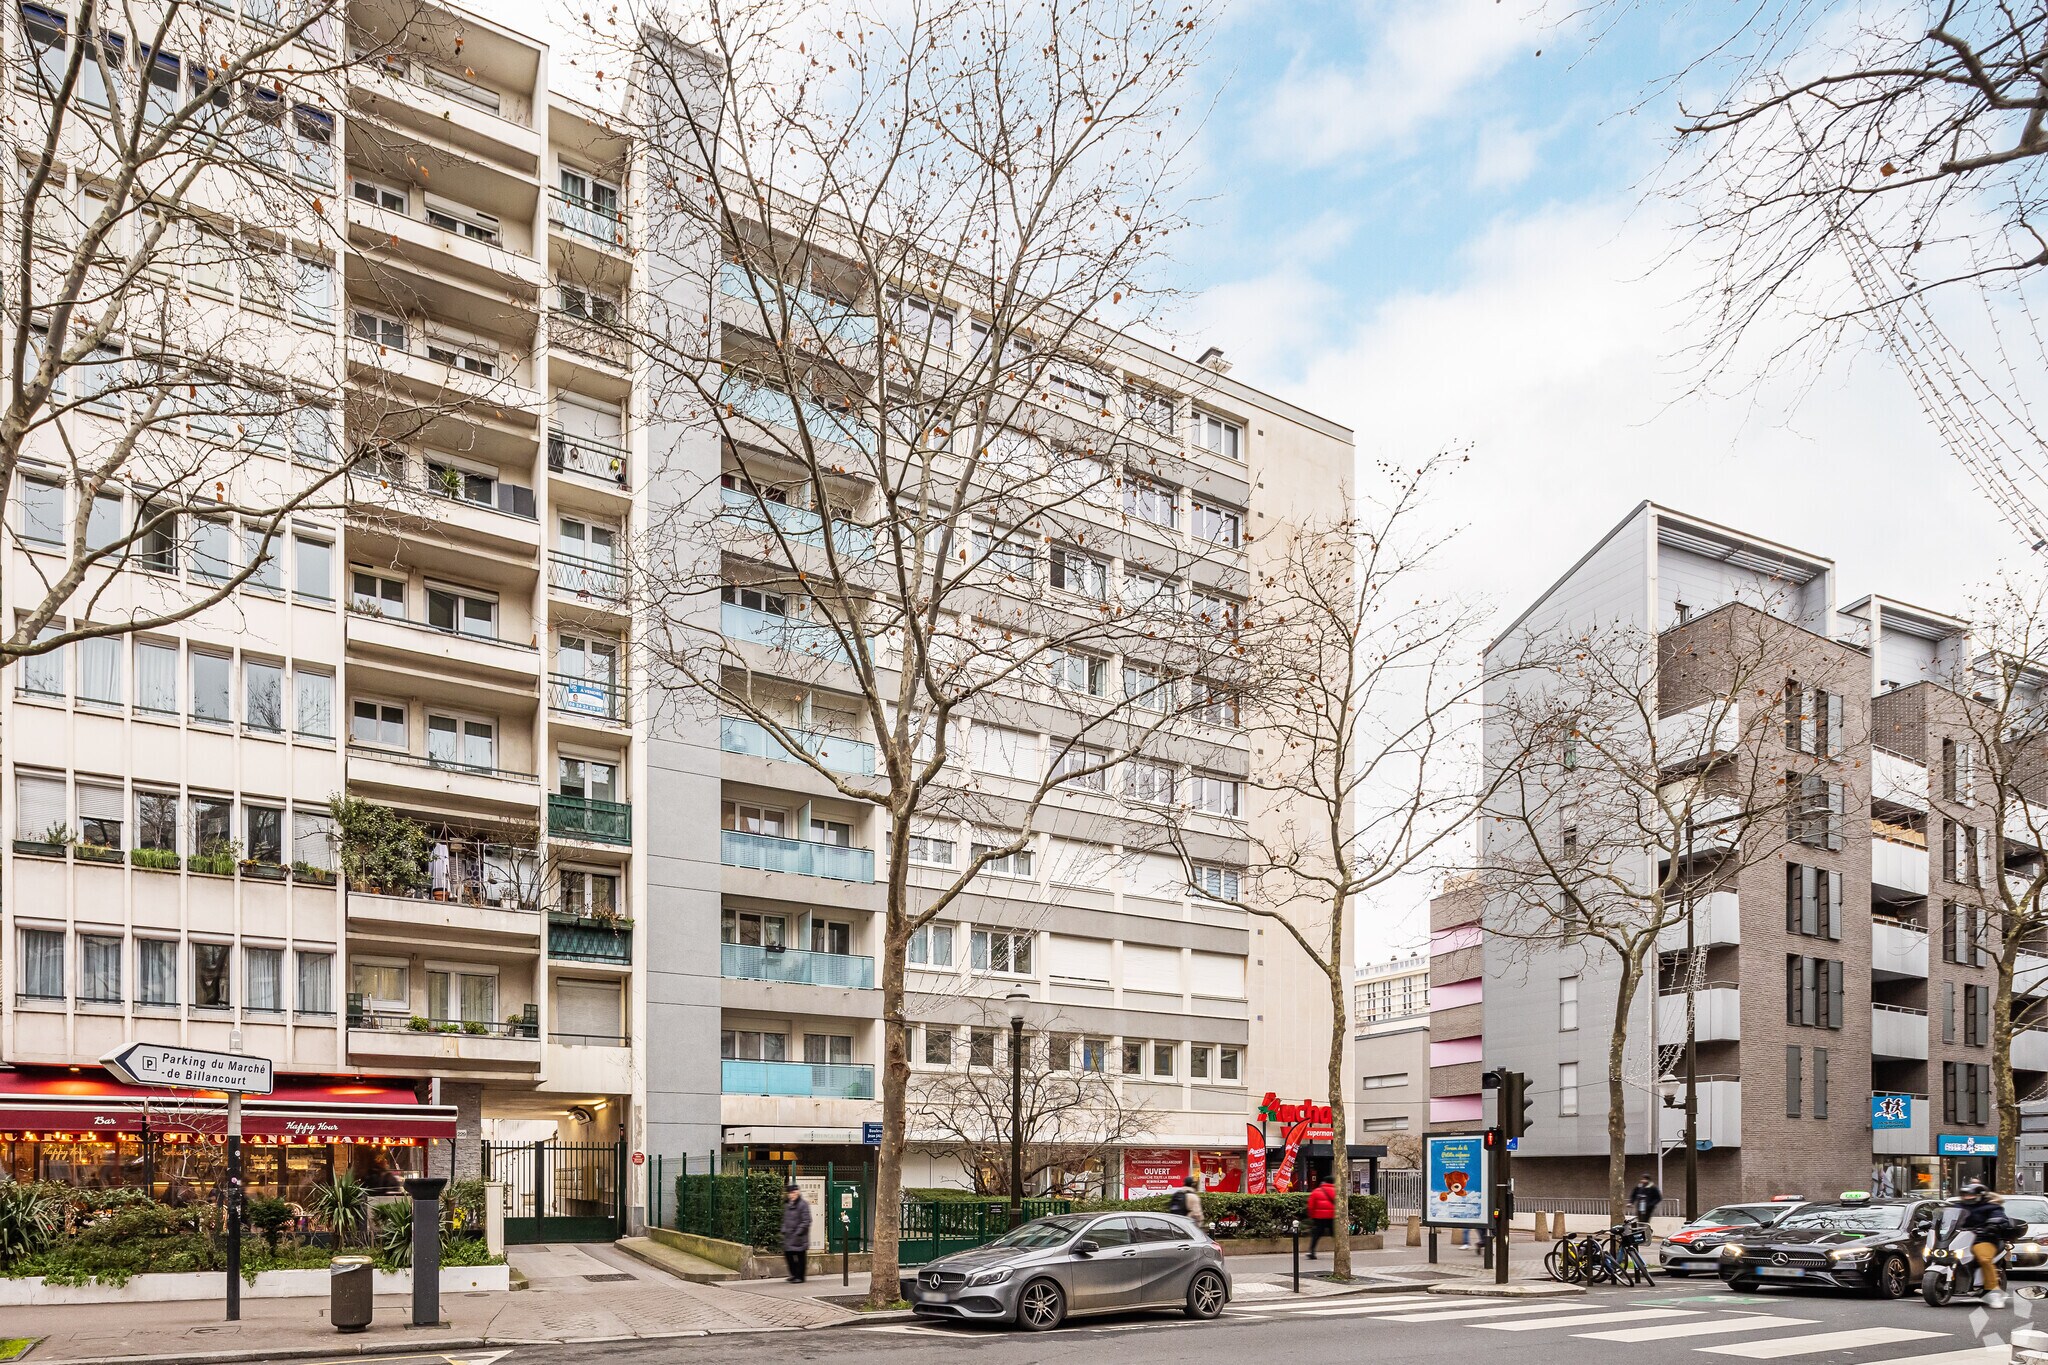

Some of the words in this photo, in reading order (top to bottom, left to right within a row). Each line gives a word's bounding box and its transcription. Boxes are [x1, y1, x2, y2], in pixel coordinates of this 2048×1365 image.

[162, 1052, 206, 1070] Parking
[211, 1058, 224, 1069] du
[227, 1060, 266, 1074] Marché
[185, 1069, 247, 1085] Billancourt
[1257, 1092, 1333, 1124] Aucha
[94, 1116, 117, 1125] Bar
[285, 1121, 317, 1134] Happy
[317, 1121, 339, 1131] Hour
[126, 1132, 296, 1144] RESTAUANT
[1306, 1130, 1334, 1138] supermar
[1144, 1167, 1171, 1175] OUVERT
